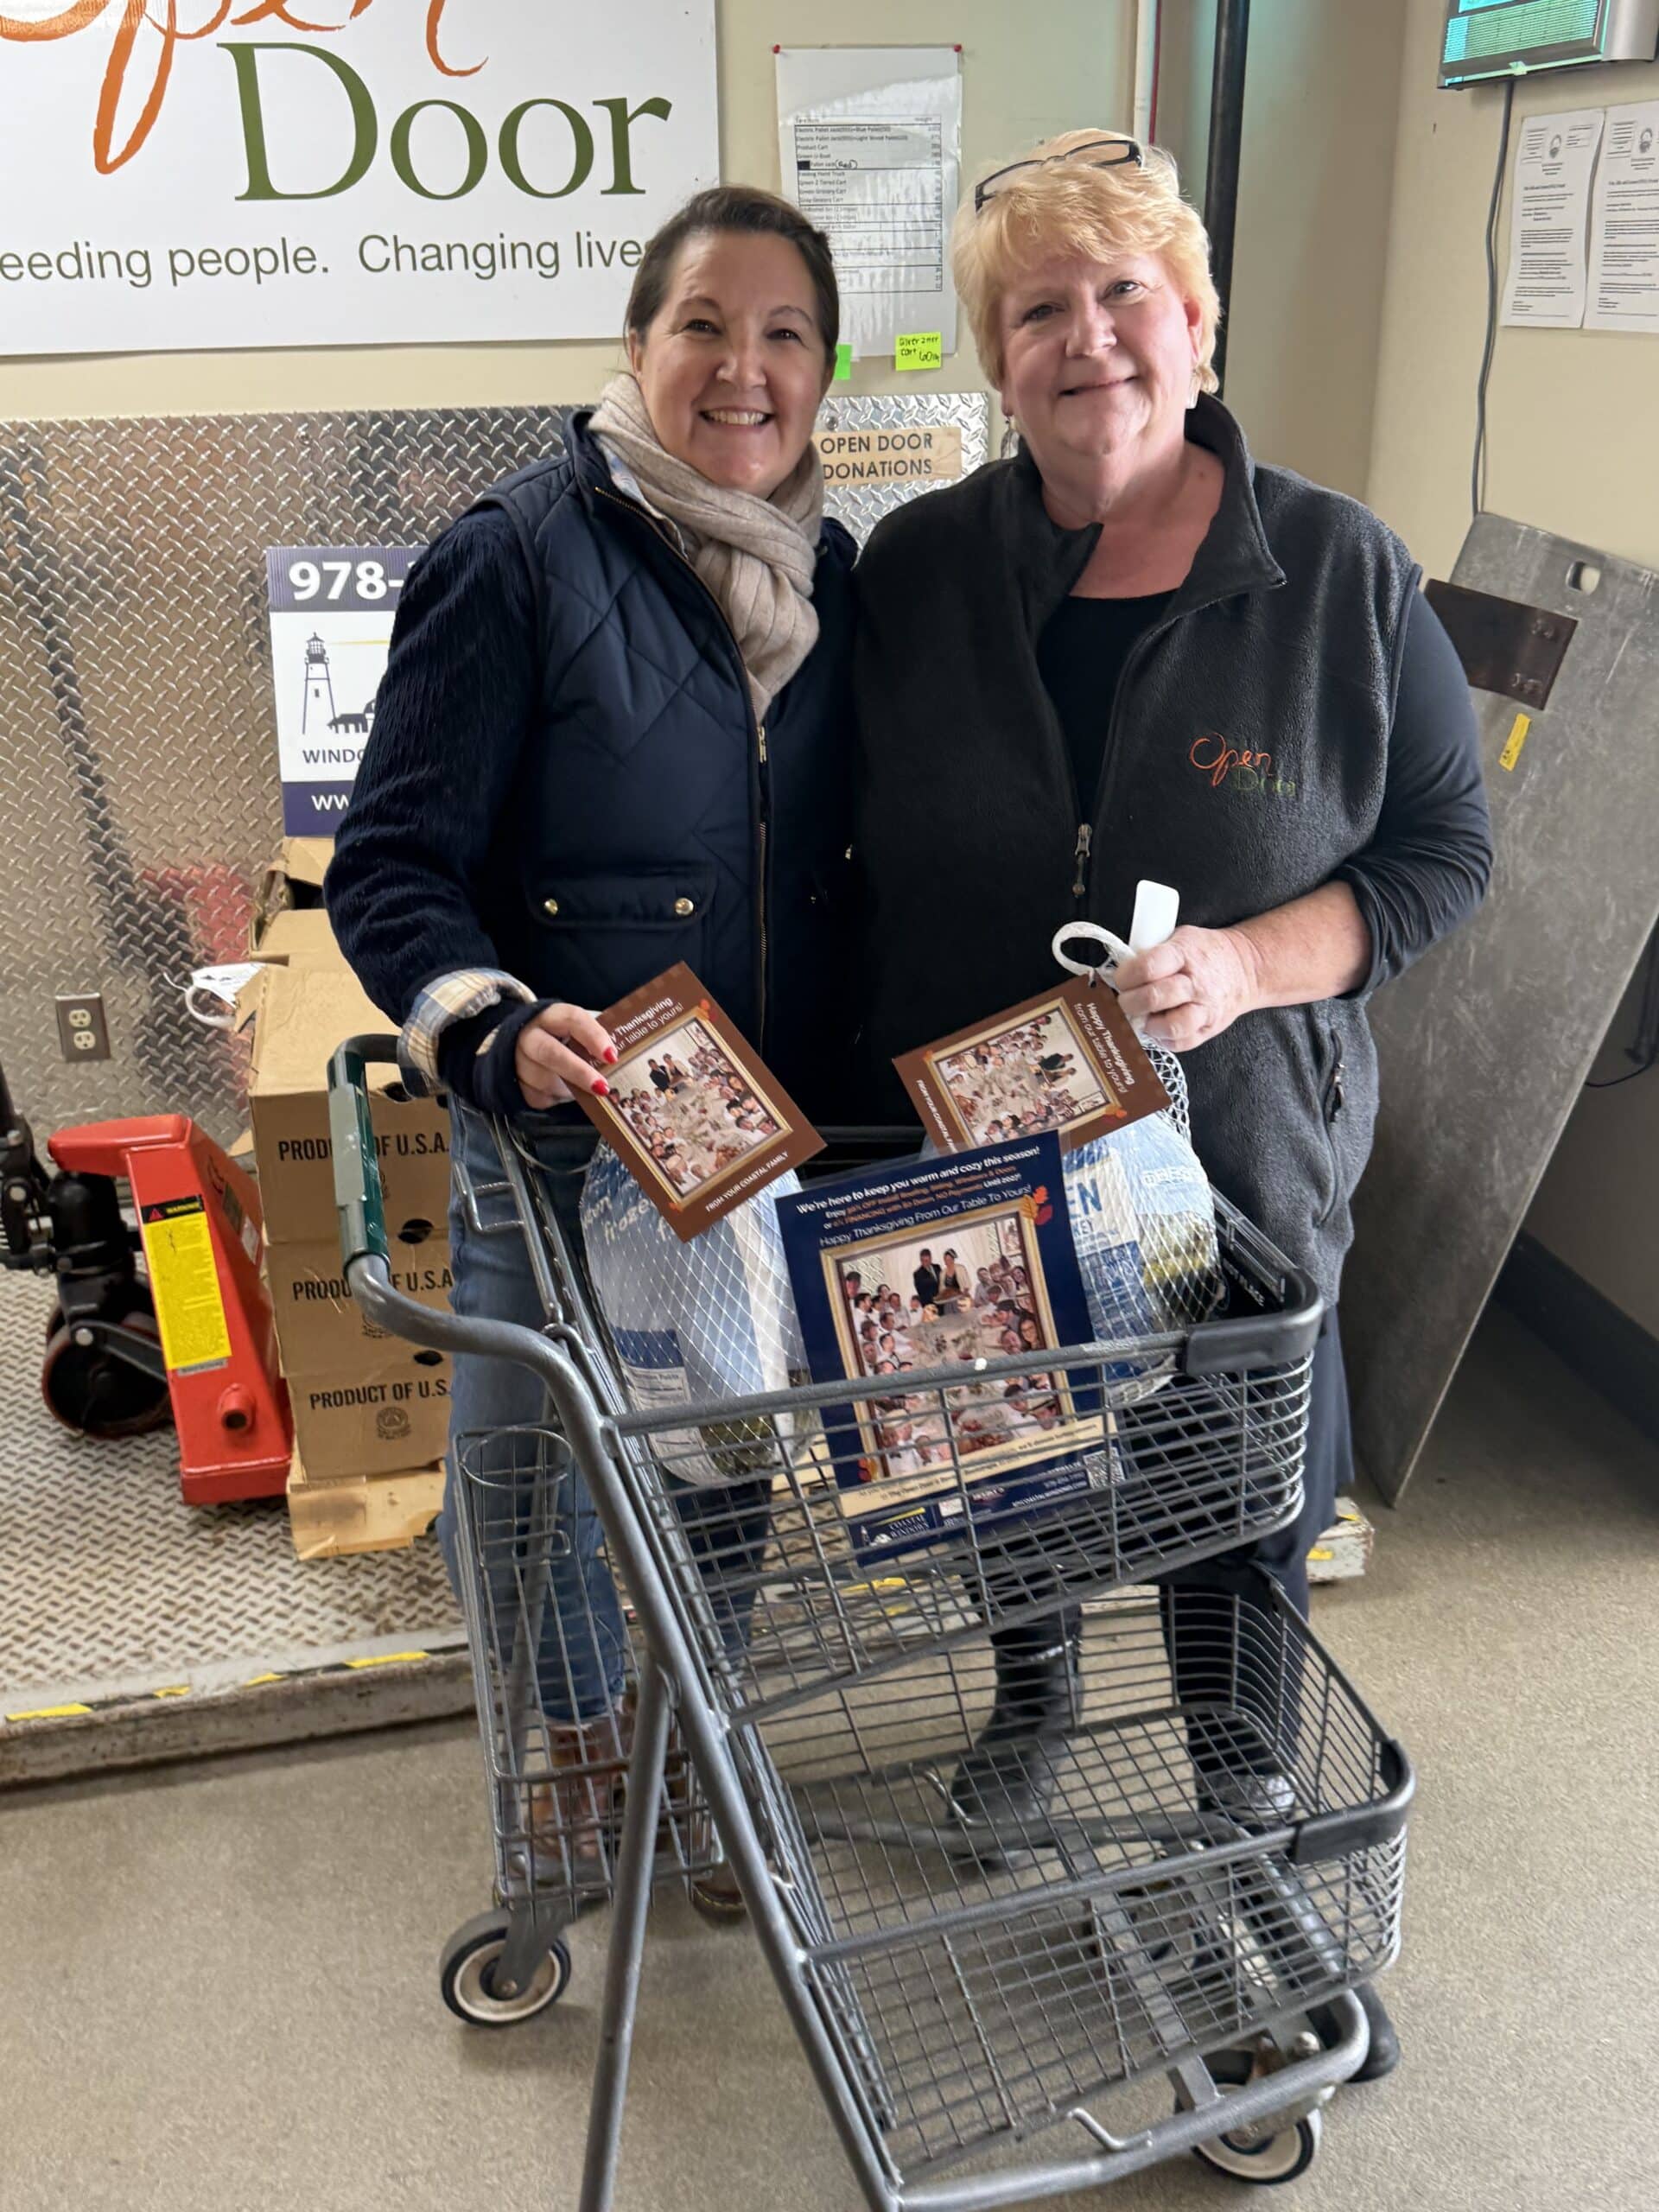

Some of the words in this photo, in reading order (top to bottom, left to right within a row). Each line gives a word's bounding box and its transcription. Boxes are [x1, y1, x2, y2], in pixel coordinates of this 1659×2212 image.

[217, 41, 672, 200] Door
[168, 237, 330, 286] people.
[359, 232, 561, 281] Changing
[820, 435, 871, 454] OPEN
[877, 432, 933, 450] DOOR
[823, 459, 933, 480] DONATIONS
[289, 561, 415, 601] 978-
[1189, 732, 1274, 788] Open
[614, 995, 673, 1038] Thanksgiving
[397, 1132, 449, 1155] U.S.A.
[796, 1198, 828, 1215] We're
[827, 1192, 852, 1207] here
[852, 1190, 864, 1201] to
[863, 1183, 890, 1198] keep
[890, 1179, 910, 1192] you
[910, 1171, 938, 1186] warm
[938, 1165, 959, 1179] and
[958, 1160, 983, 1175] cozy
[982, 1154, 1002, 1168] this
[1001, 1145, 1040, 1163] season!
[819, 1230, 852, 1249] Happy
[853, 1214, 914, 1239] Thanksgiving
[914, 1207, 940, 1221] From
[941, 1202, 959, 1215] Our
[960, 1195, 987, 1210] Table
[987, 1192, 1001, 1203] To
[1001, 1184, 1032, 1199] Yours!
[310, 1384, 387, 1408] PRODUCT
[392, 1382, 414, 1401] OF
